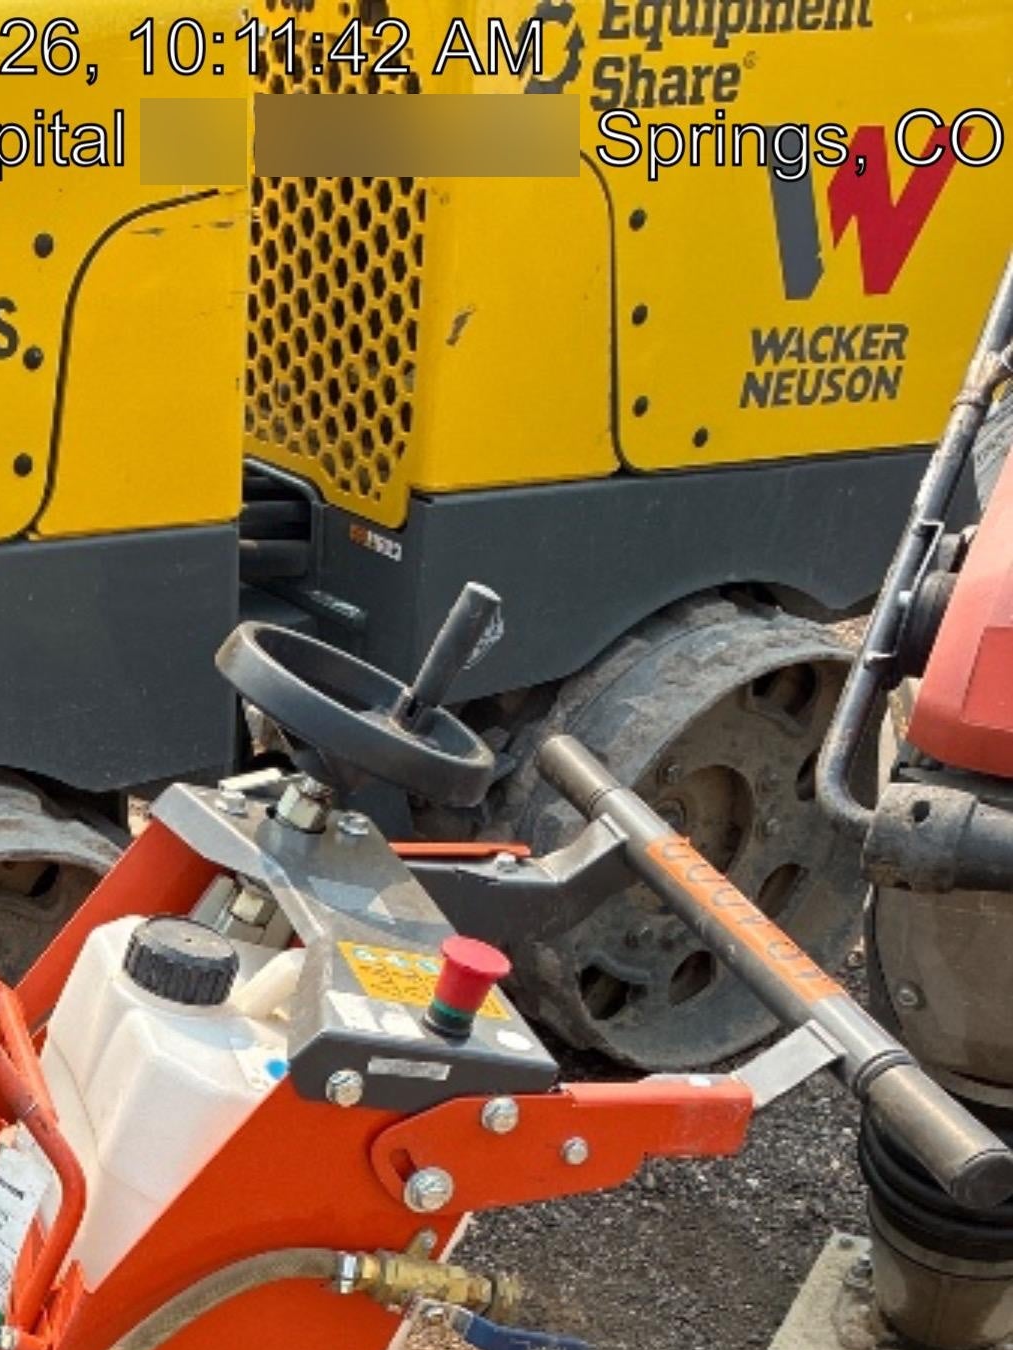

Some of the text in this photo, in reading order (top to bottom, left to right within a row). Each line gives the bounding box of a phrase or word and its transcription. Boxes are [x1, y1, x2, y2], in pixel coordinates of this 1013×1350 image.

[599, 0, 873, 50] Equipment
[589, 54, 742, 112] Share
[751, 323, 909, 365] WACKER
[739, 366, 903, 409] NEUSON
